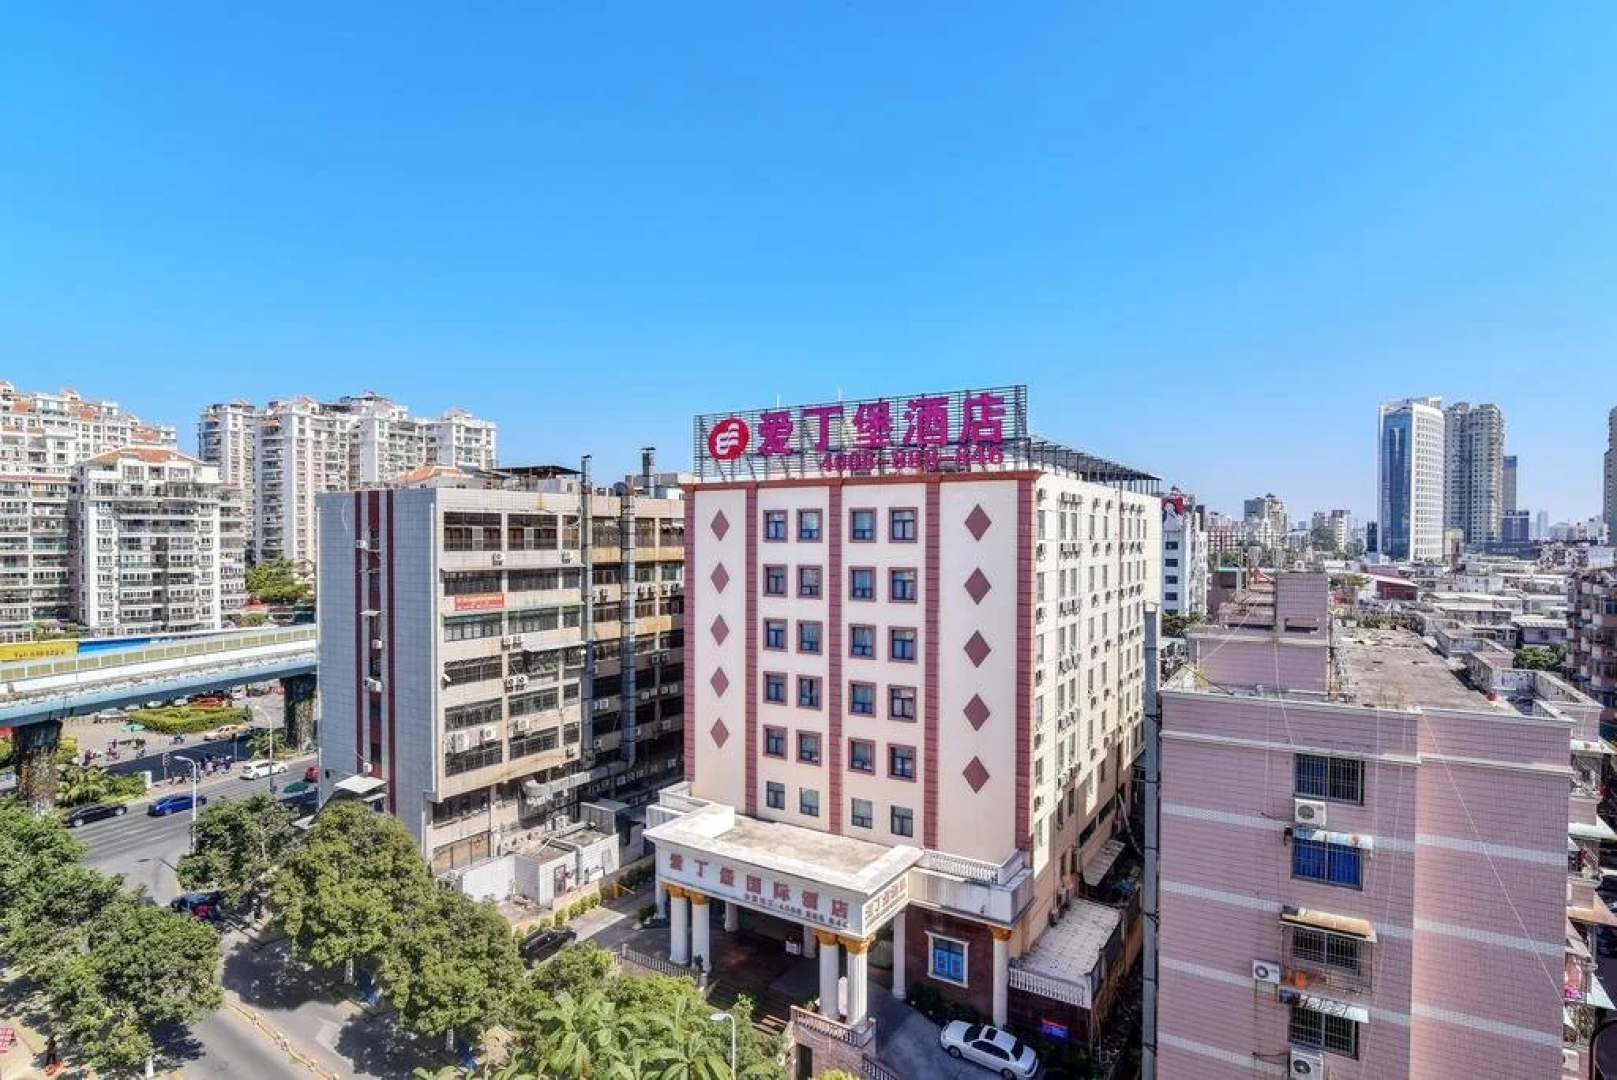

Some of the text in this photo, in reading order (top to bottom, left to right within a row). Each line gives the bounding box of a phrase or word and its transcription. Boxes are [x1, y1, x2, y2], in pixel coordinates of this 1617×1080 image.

[757, 392, 1005, 457] 爱丁堡酒店
[669, 853, 849, 919] 爱丁堡国际酒店
